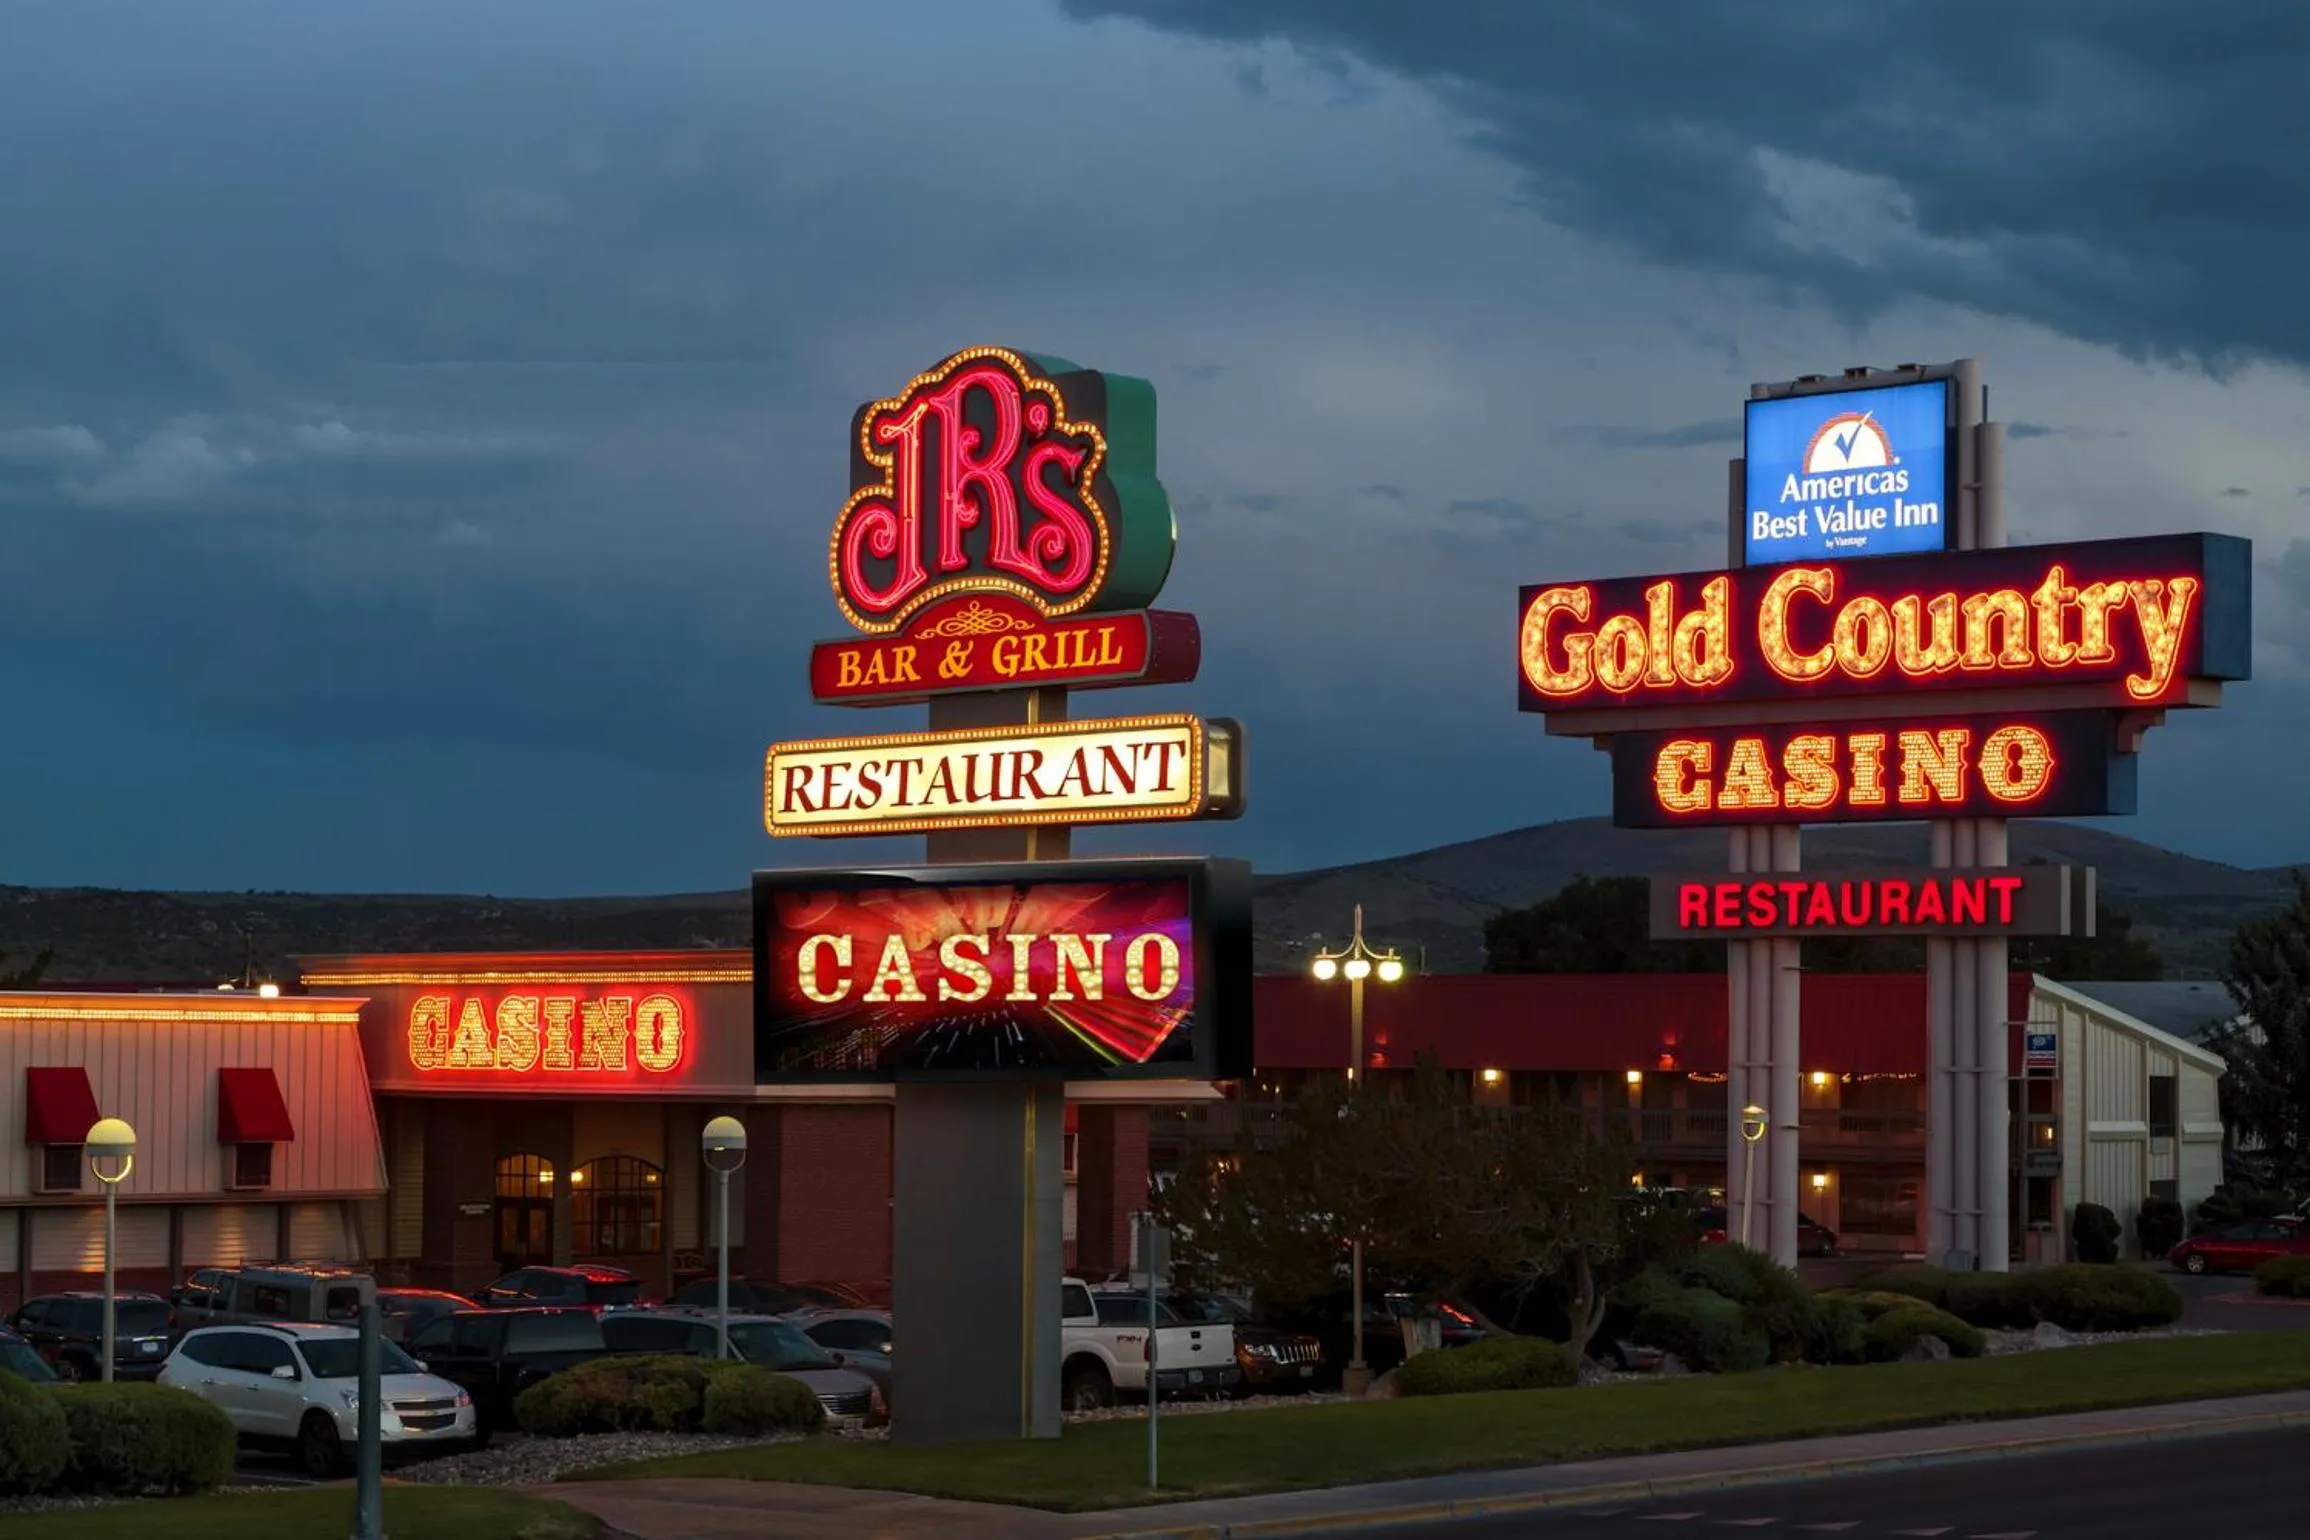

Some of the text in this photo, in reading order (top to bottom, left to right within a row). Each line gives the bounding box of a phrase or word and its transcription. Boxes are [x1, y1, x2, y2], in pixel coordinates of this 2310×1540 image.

[1752, 498, 1938, 540] Best Value Inn
[1780, 468, 1909, 503] Americas
[836, 627, 1123, 688] BAR & GRILL
[1521, 566, 2198, 699] Gold Country
[777, 739, 1187, 814] RESTAURANT
[1653, 725, 2055, 813] CASINO
[1679, 877, 2022, 928] RESTAURANT
[798, 932, 1181, 1003] CASINO
[408, 994, 685, 1072] CASINO
